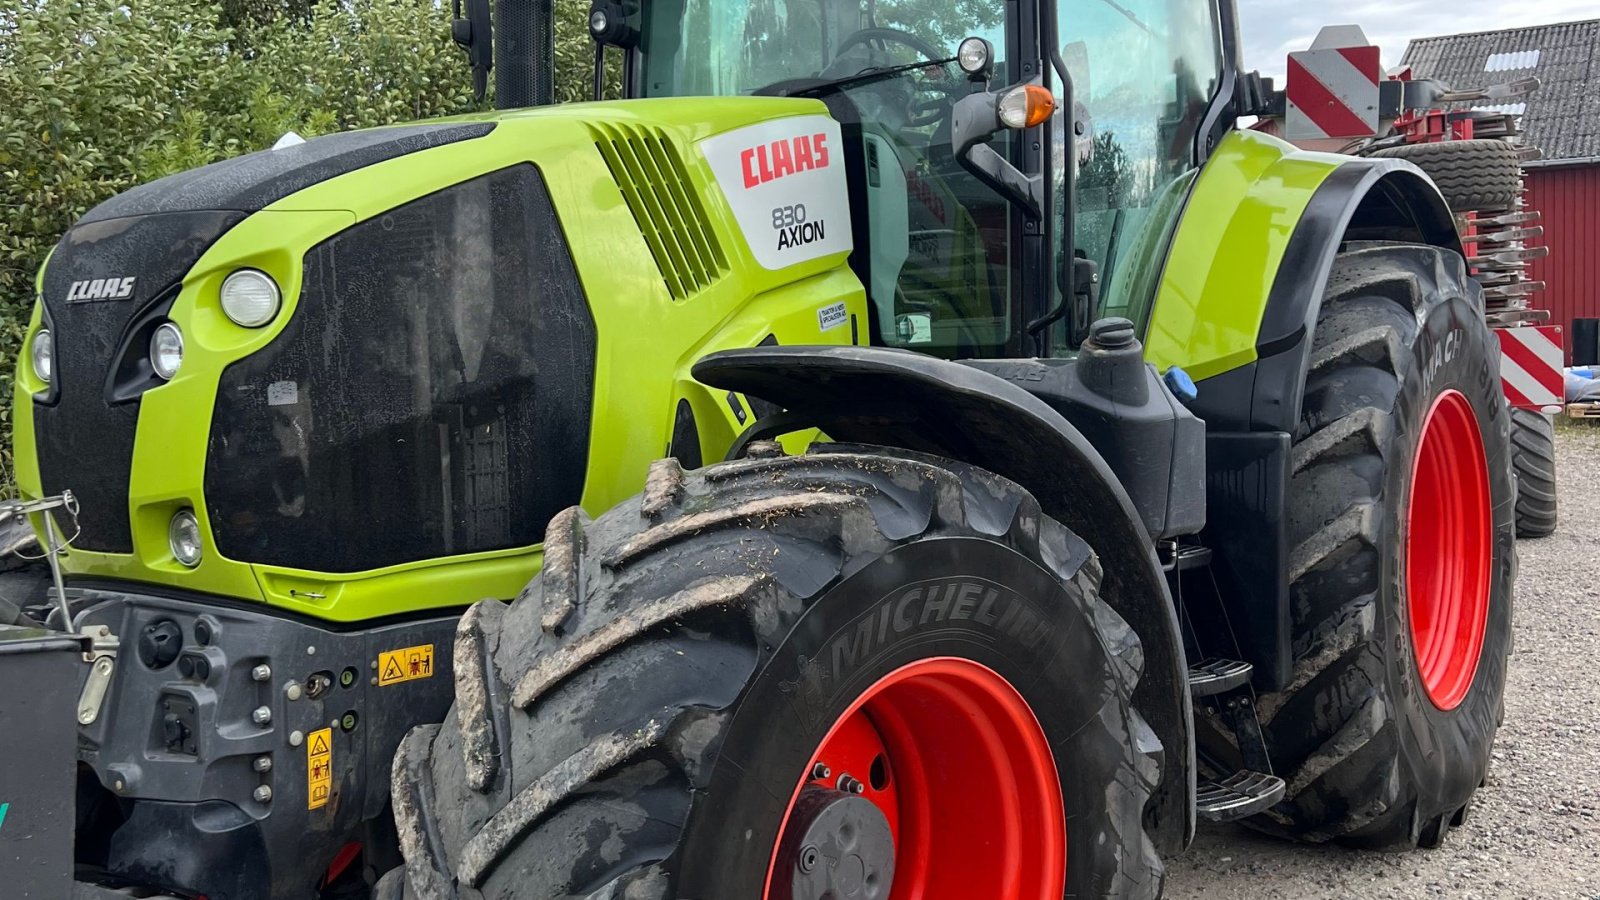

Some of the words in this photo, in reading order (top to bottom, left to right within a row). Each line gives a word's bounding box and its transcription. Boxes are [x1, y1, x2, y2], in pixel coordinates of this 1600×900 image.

[740, 133, 829, 189] CLAAS
[771, 203, 806, 229] 830
[777, 219, 825, 251] AXION
[66, 276, 136, 301] CLAAS
[1422, 328, 1463, 397] MACH
[1479, 358, 1499, 422] BIB
[831, 582, 1057, 681] MICHELIN
